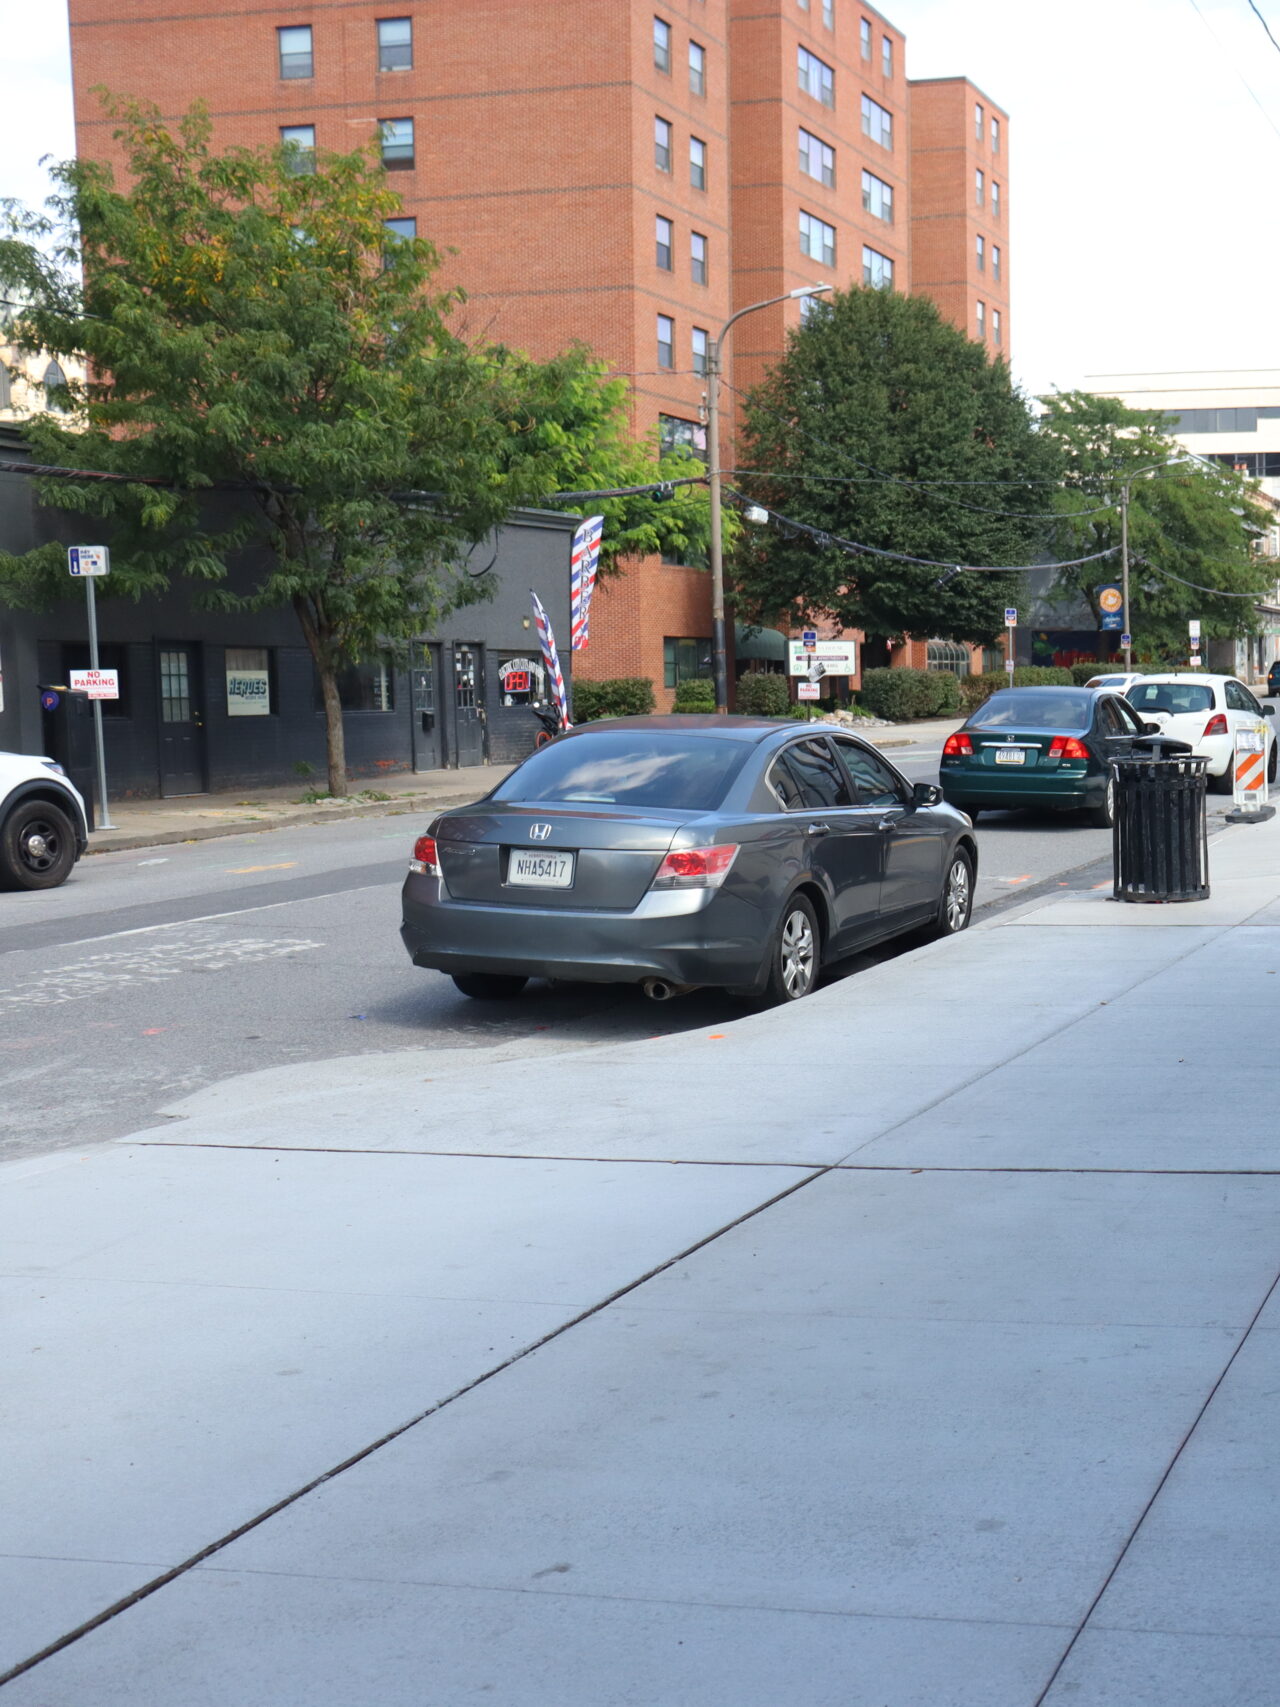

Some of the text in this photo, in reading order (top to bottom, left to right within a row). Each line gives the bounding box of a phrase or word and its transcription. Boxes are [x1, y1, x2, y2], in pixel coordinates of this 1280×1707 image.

[579, 528, 594, 620] BARBER
[74, 679, 115, 687] PARKING
[87, 671, 101, 679] NO
[505, 671, 529, 691] OPEN
[229, 677, 267, 697] HEROES
[516, 859, 567, 878] NHA5417
